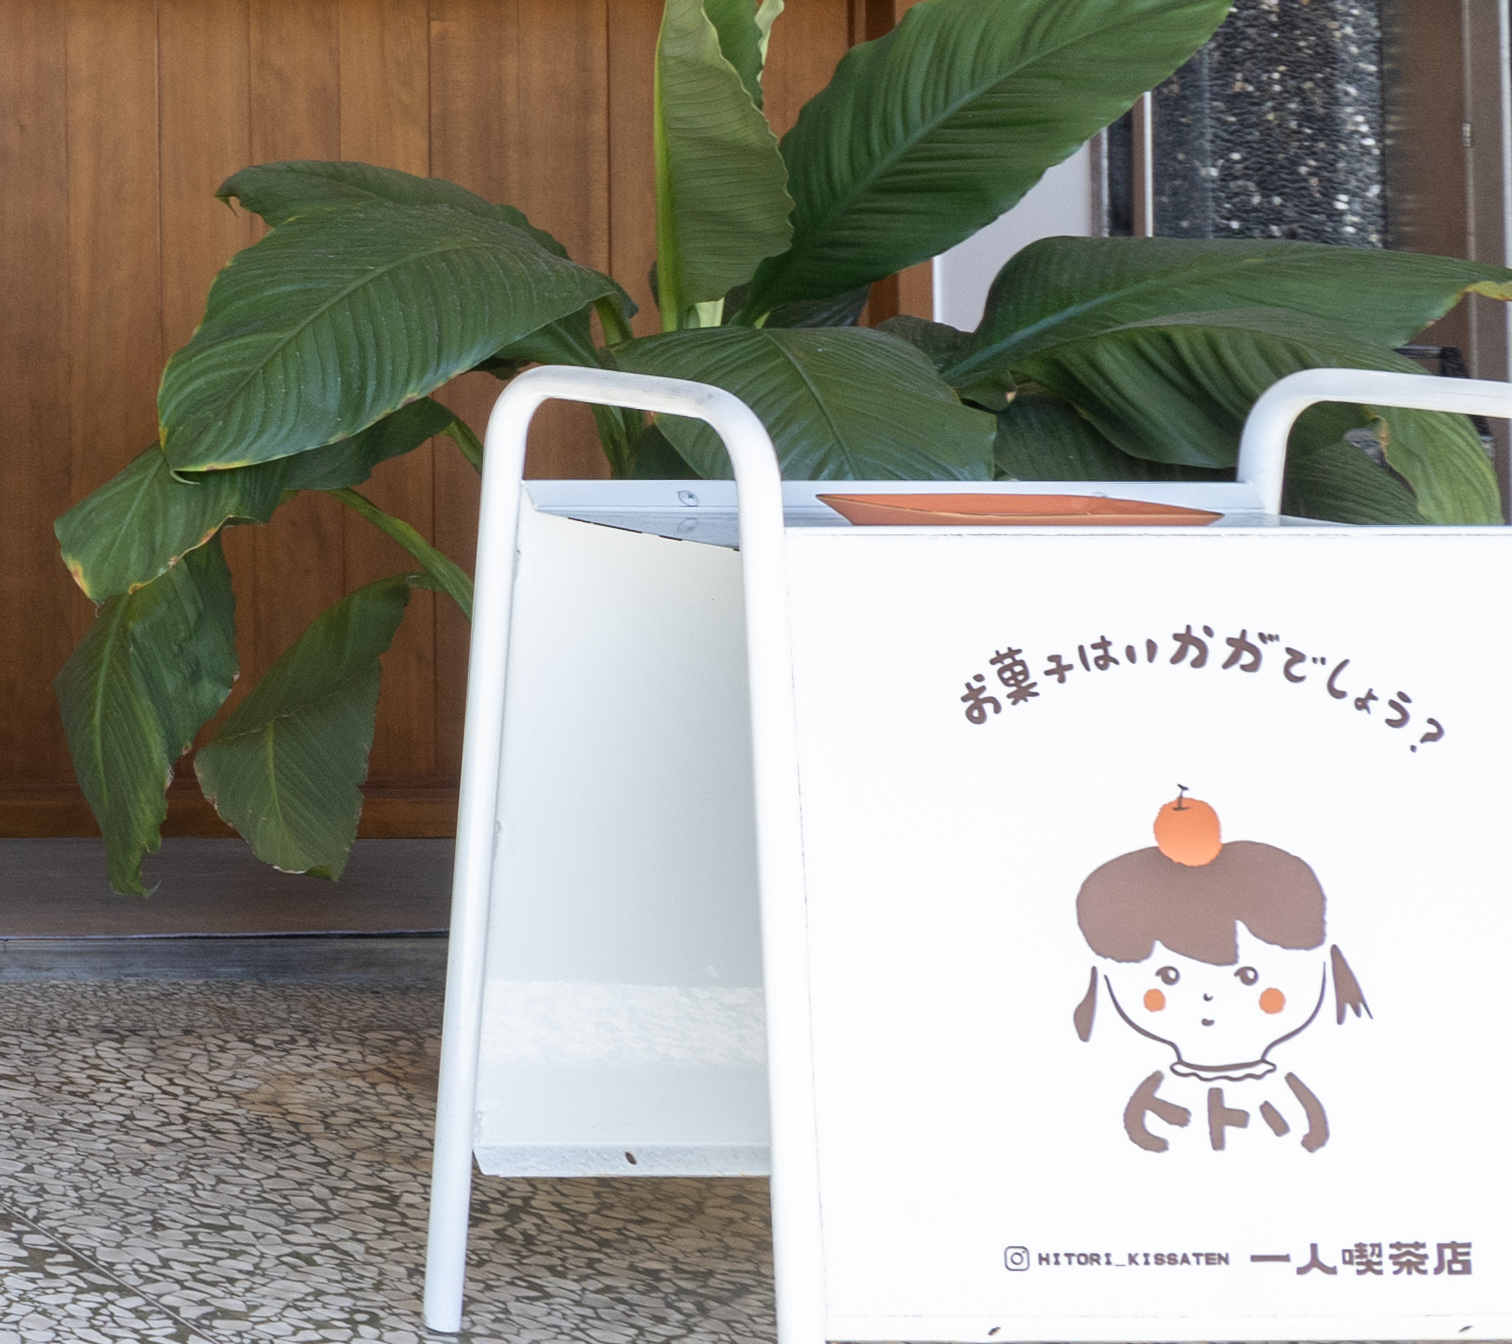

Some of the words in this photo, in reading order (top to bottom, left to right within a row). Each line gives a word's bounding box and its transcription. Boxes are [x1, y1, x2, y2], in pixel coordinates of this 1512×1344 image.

[960, 624, 1445, 753] お菓子はいかがでしょう?
[1122, 1070, 1331, 1154] ヒトリ
[1037, 1252, 1230, 1267] HITORI_KISSATEN
[1249, 1240, 1473, 1276] 一人喫茶店
